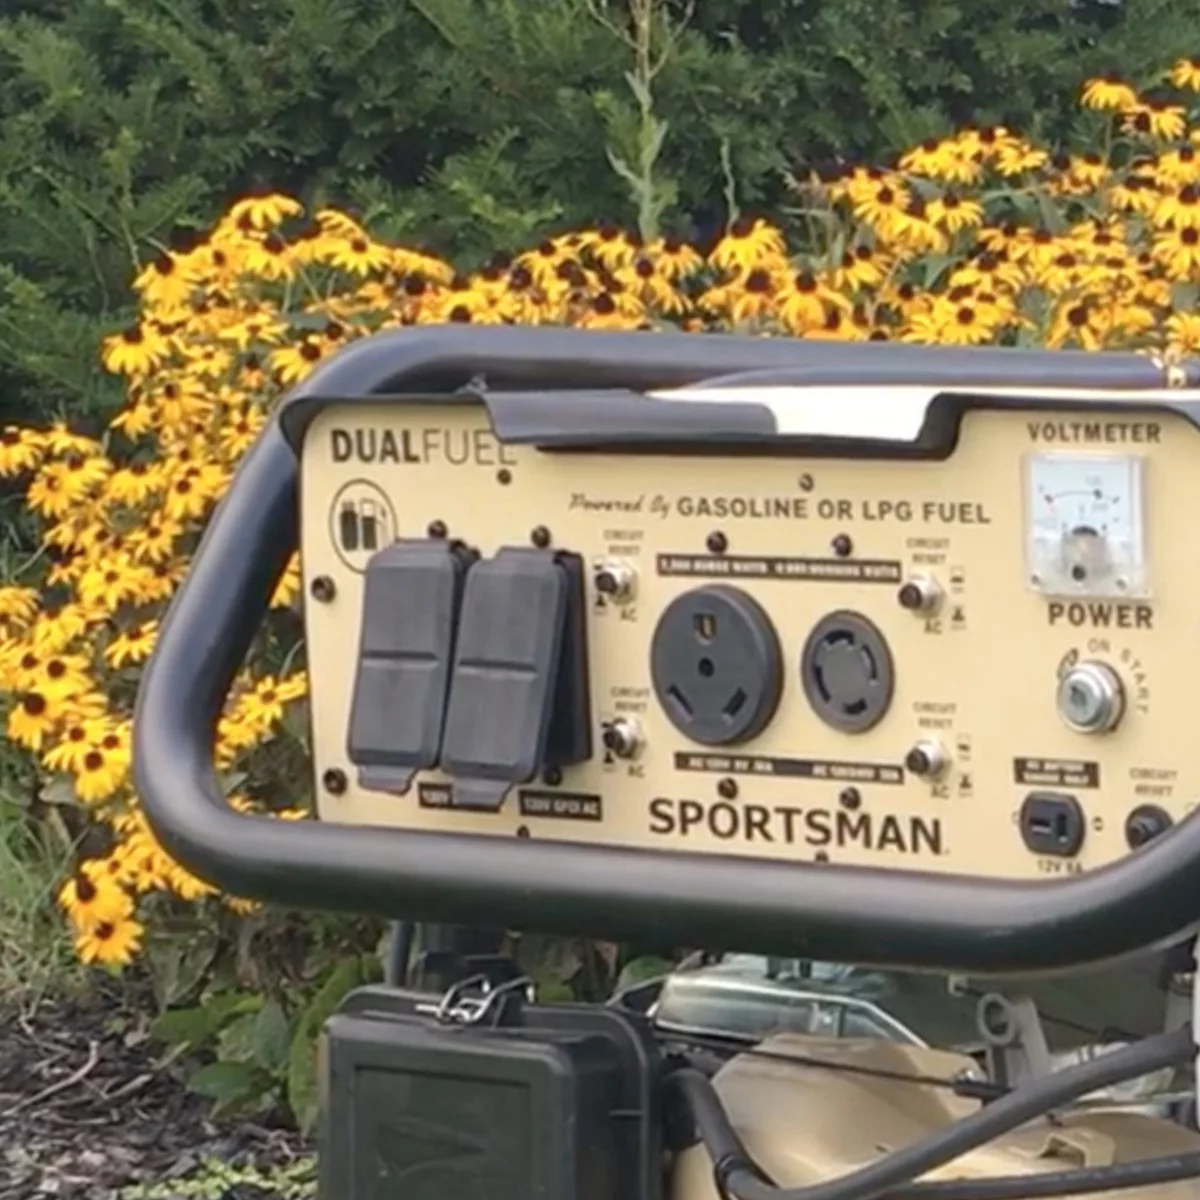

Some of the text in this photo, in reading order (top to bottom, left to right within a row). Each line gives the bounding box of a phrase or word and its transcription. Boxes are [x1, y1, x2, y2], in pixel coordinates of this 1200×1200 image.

[1027, 422, 1161, 443] VOLTMETER
[677, 497, 809, 519] GASOLINE
[817, 500, 853, 520] OR
[862, 500, 912, 522] LPG
[922, 502, 991, 524] FUEL
[1048, 602, 1154, 629] POWER
[649, 798, 943, 855] SPORTSMAN
